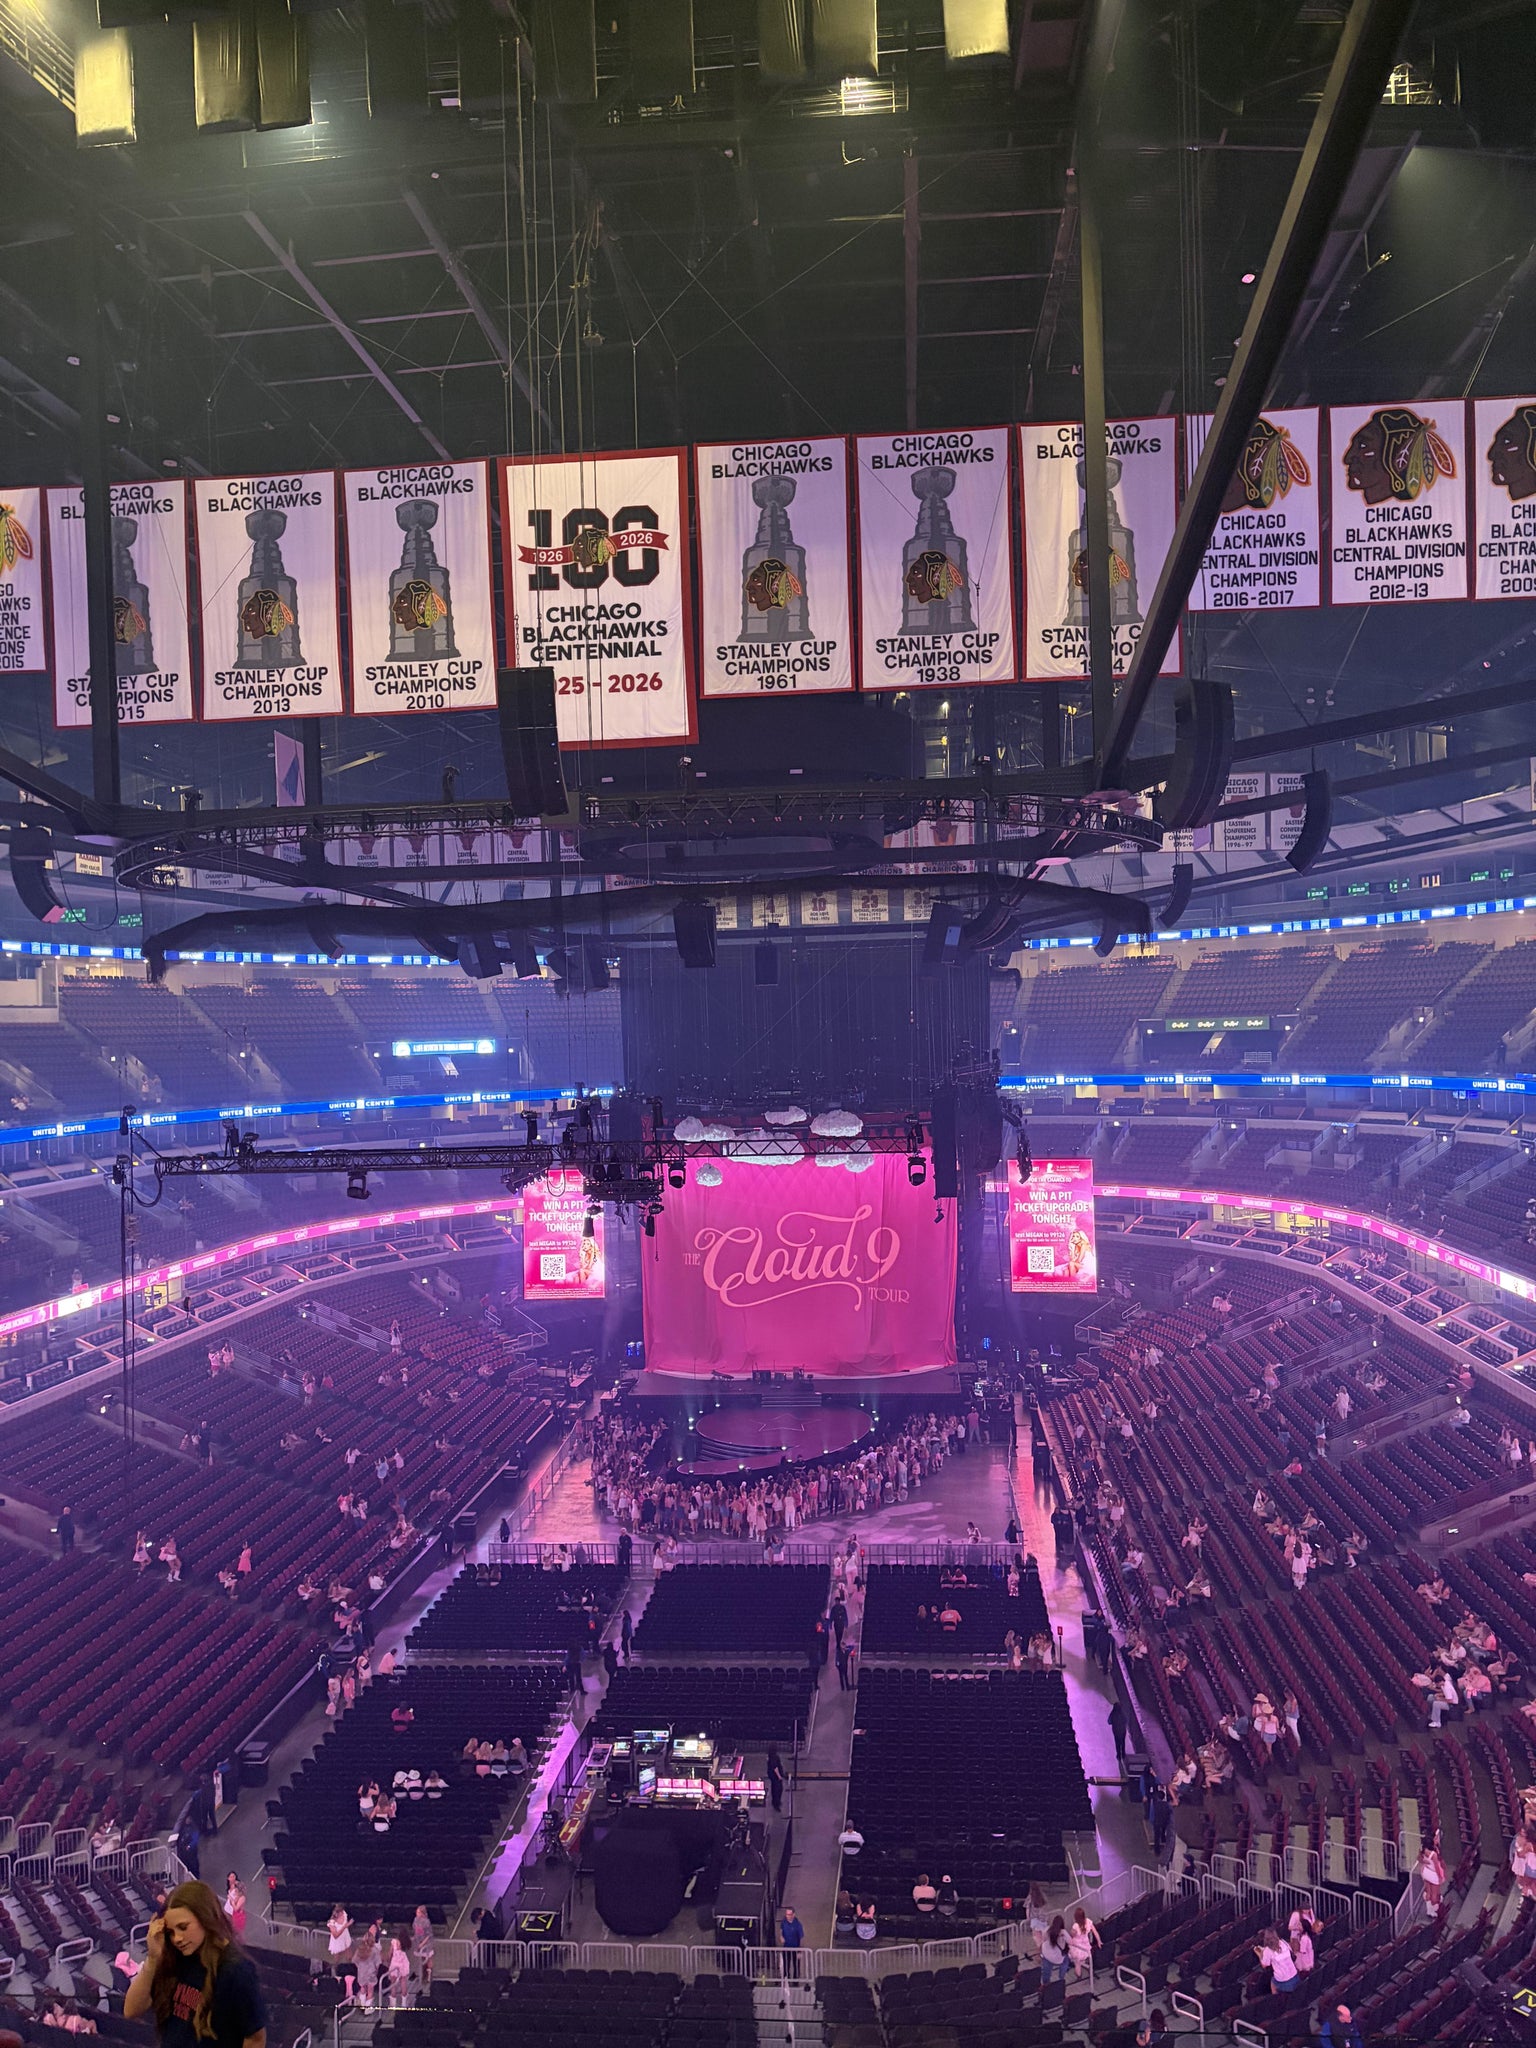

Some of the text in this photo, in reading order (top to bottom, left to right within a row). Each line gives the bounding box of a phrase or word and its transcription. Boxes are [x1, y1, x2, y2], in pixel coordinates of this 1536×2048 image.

[1057, 423, 1140, 442] CHAGO
[892, 434, 973, 452] CHICAGO
[1037, 438, 1161, 459] BLACAWKS
[731, 443, 812, 462] CHICAGO
[871, 448, 994, 470] BLACKHAWKS
[376, 465, 454, 484] CHICAGO
[712, 457, 833, 479] BLACKHAWKS
[79, 486, 154, 502] CAGO
[227, 478, 303, 496] CHICAGO
[357, 478, 474, 502] BLACKHAWKS
[60, 499, 174, 520] BLHAWKS
[208, 492, 322, 513] BLACKHAWKS
[1221, 514, 1286, 530] CHICAGO
[1366, 505, 1432, 523] CHICAGO
[620, 532, 653, 545] 2026
[1346, 523, 1453, 543] BLACKHAWKS
[528, 505, 660, 591] 100
[532, 550, 563, 563] 1926
[1333, 542, 1465, 563] CENTRAL DIVISION
[1479, 541, 1536, 558] CENTRA
[1202, 550, 1318, 569] ENTRAL DIVISION
[1210, 571, 1297, 588] CHAMPIONS
[1354, 563, 1444, 581] CHAMPIONS
[1213, 590, 1294, 607] 2016-2017
[1370, 583, 1428, 600] 2012-13
[545, 602, 642, 623] CHICAGO
[522, 620, 668, 644] BLACKHAWKS
[1041, 626, 1120, 643] STANY
[530, 640, 662, 662] CENTENNIAL
[716, 640, 837, 661] STANLEY CUP
[875, 633, 1000, 654] STANLEY CUP
[1050, 641, 1139, 659] CHAIO
[724, 657, 830, 676] CHAMPIONS
[884, 649, 993, 670] CHAMPIONS
[1080, 658, 1125, 674] 14
[214, 666, 329, 686] STANLEY CUP
[365, 660, 483, 681] STANLEY CUP
[916, 666, 961, 682] 1938
[67, 673, 179, 692] STEY CUP
[222, 682, 322, 700] CHAMPIONS
[374, 676, 476, 696] CHAMPIONS
[553, 675, 585, 696] 25
[607, 672, 663, 693] 2026
[756, 674, 798, 690] 1961
[76, 689, 174, 707] CPIONS
[253, 698, 291, 714] 2013
[406, 694, 445, 710] 2010
[117, 705, 145, 720] 015
[812, 898, 827, 911] 10
[1472, 1081, 1525, 1090] UNITED CENTER
[365, 1099, 395, 1107] CENTER
[481, 1093, 511, 1101] CENTER
[151, 1115, 177, 1123] CENTER
[219, 1107, 282, 1117] UNITED CENTER
[32, 1124, 86, 1137] UNITED CENTER
[543, 1200, 583, 1210] WIN A PIT
[1029, 1191, 1072, 1201] WIN A PIT
[1014, 1202, 1089, 1212] TICKET UPGRADE
[528, 1211, 587, 1222] TICKET UPGRA
[1031, 1214, 1072, 1224] TONIGHT
[683, 1204, 901, 1312] THE Cloud 9
[868, 1287, 910, 1304] TOUR
